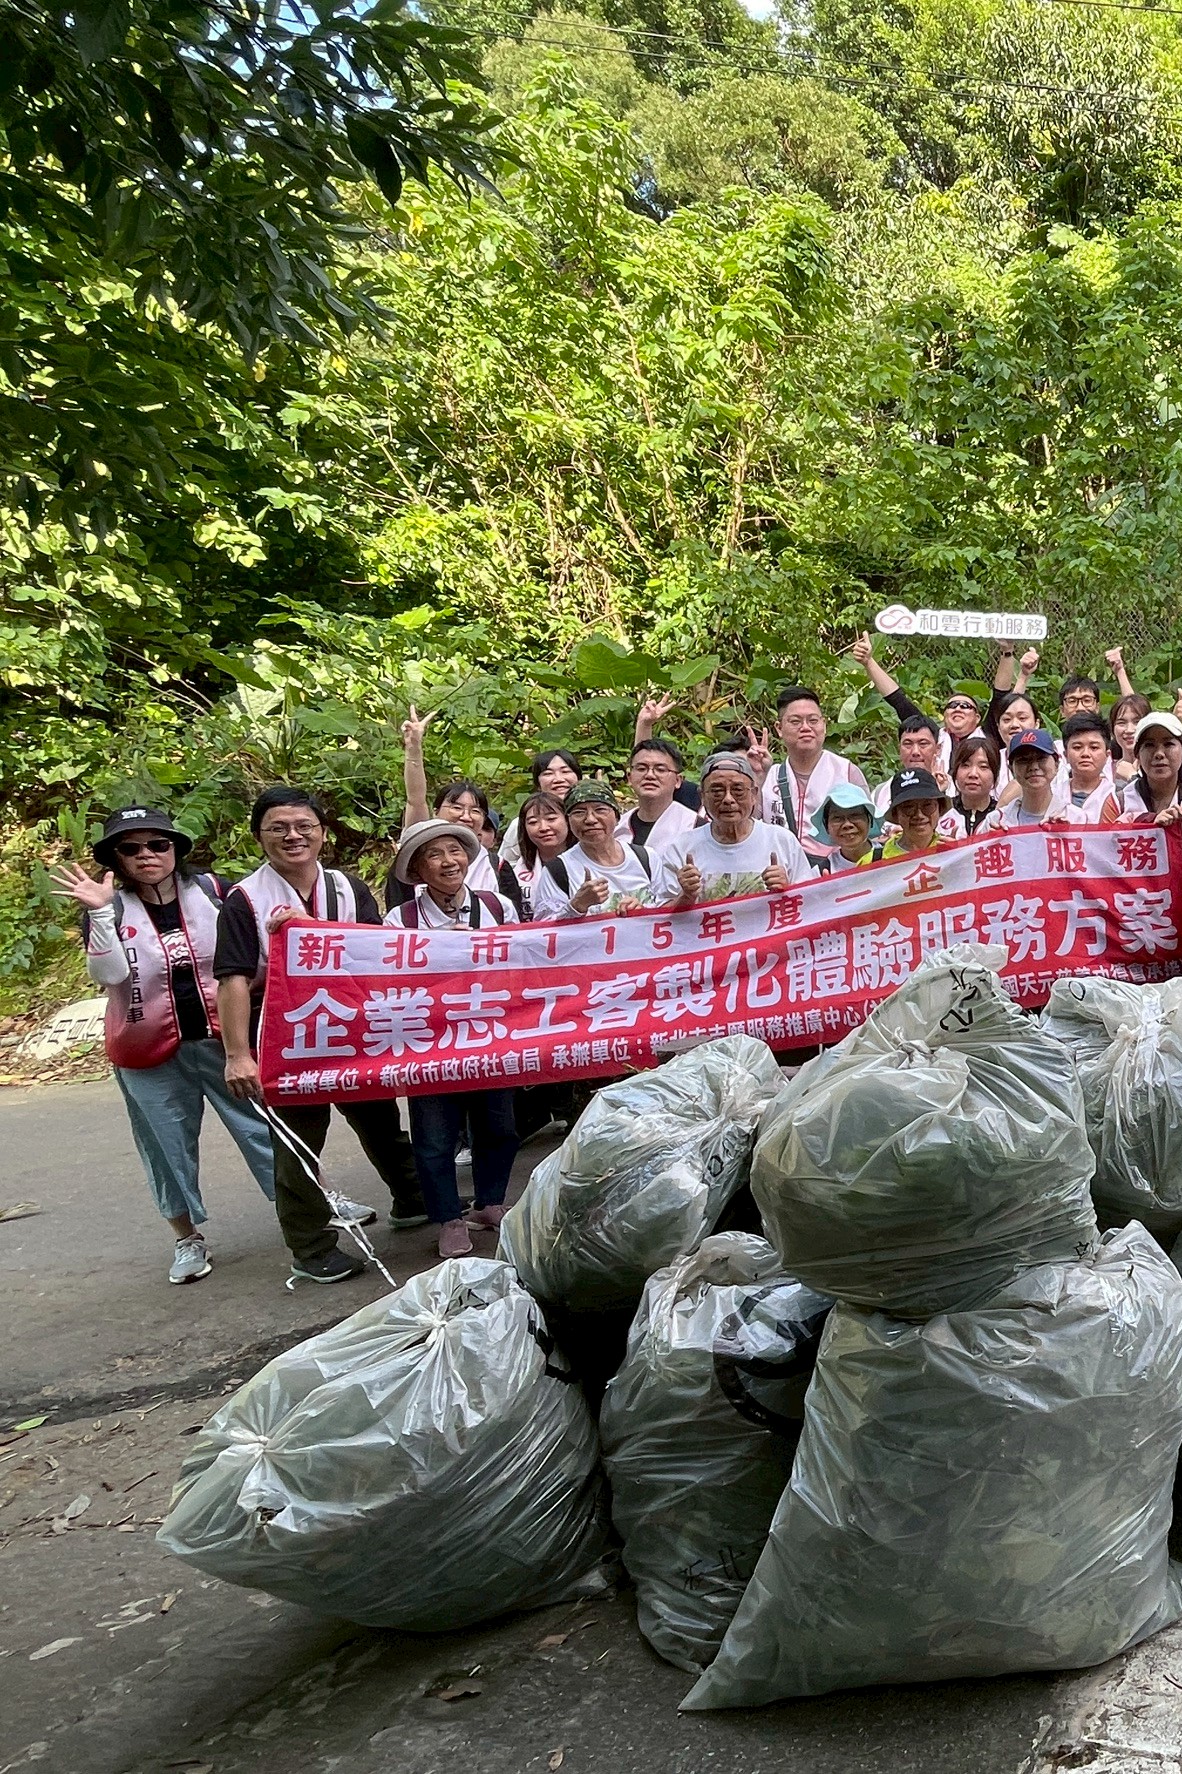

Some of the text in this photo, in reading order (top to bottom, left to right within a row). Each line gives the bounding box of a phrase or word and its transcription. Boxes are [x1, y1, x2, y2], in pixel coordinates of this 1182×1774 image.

[919, 613, 1043, 636] 和雲行動服務
[281, 887, 1179, 1059] 企業志工客製化體驗服務方案
